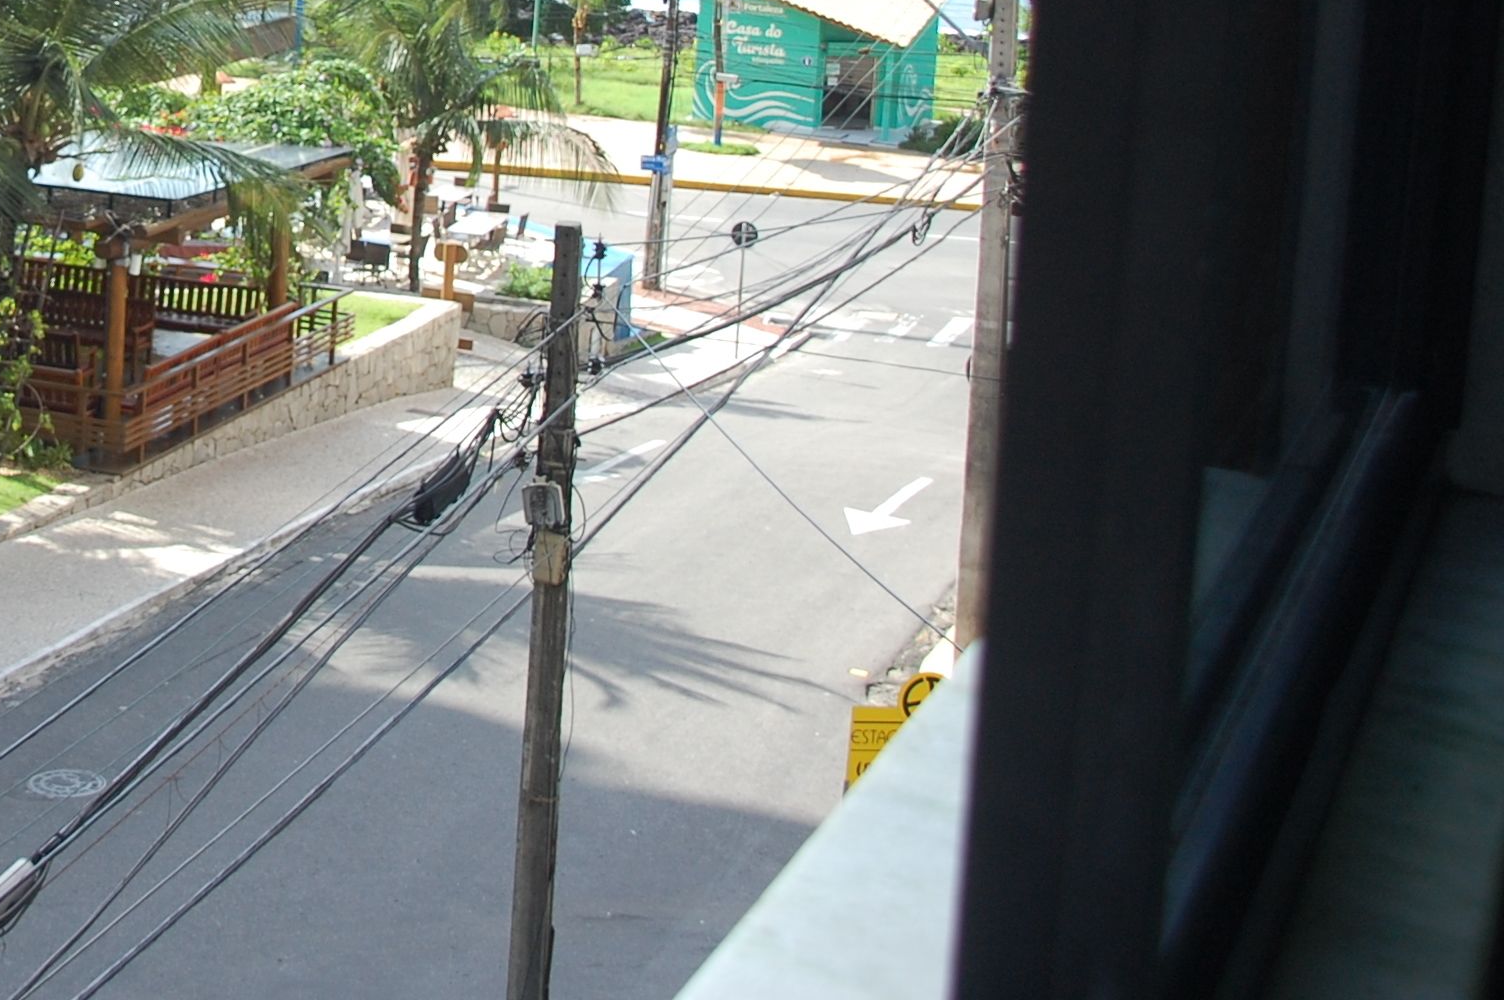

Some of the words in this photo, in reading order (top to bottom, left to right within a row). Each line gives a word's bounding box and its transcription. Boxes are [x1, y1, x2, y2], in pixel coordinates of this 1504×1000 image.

[727, 20, 762, 37] Casa
[765, 23, 783, 39] do
[731, 36, 786, 57] Turista
